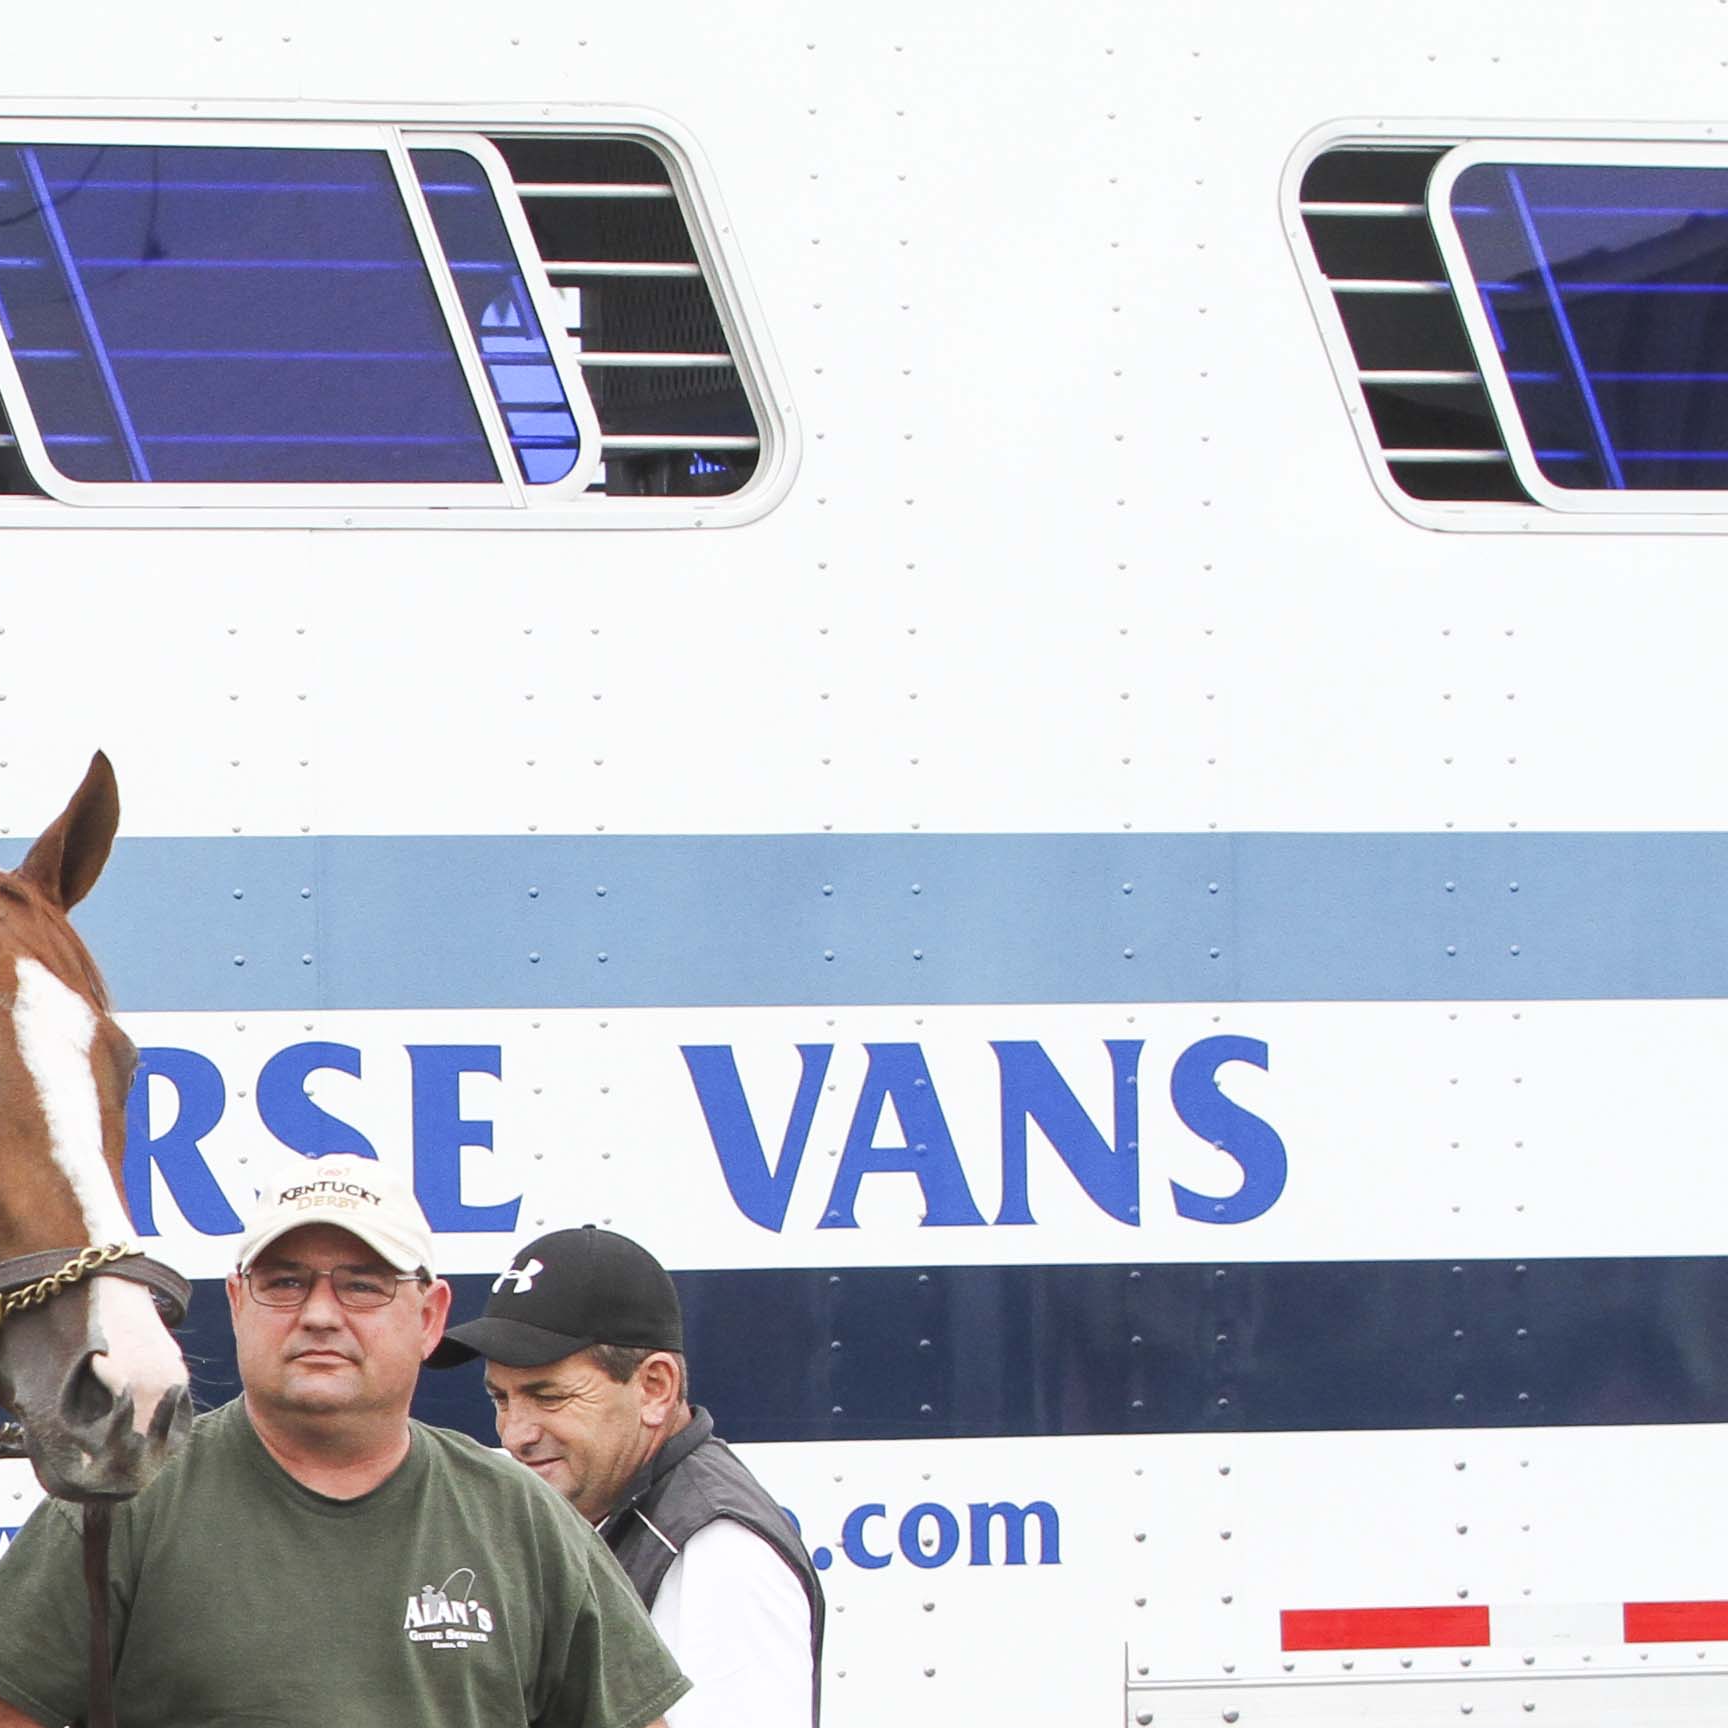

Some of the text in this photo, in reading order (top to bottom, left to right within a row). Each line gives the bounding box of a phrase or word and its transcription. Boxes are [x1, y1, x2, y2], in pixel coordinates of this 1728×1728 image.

[678, 1035, 1288, 1234] VANS
[278, 1181, 382, 1206] KENTUCKY
[295, 1196, 361, 1211] DERBY
